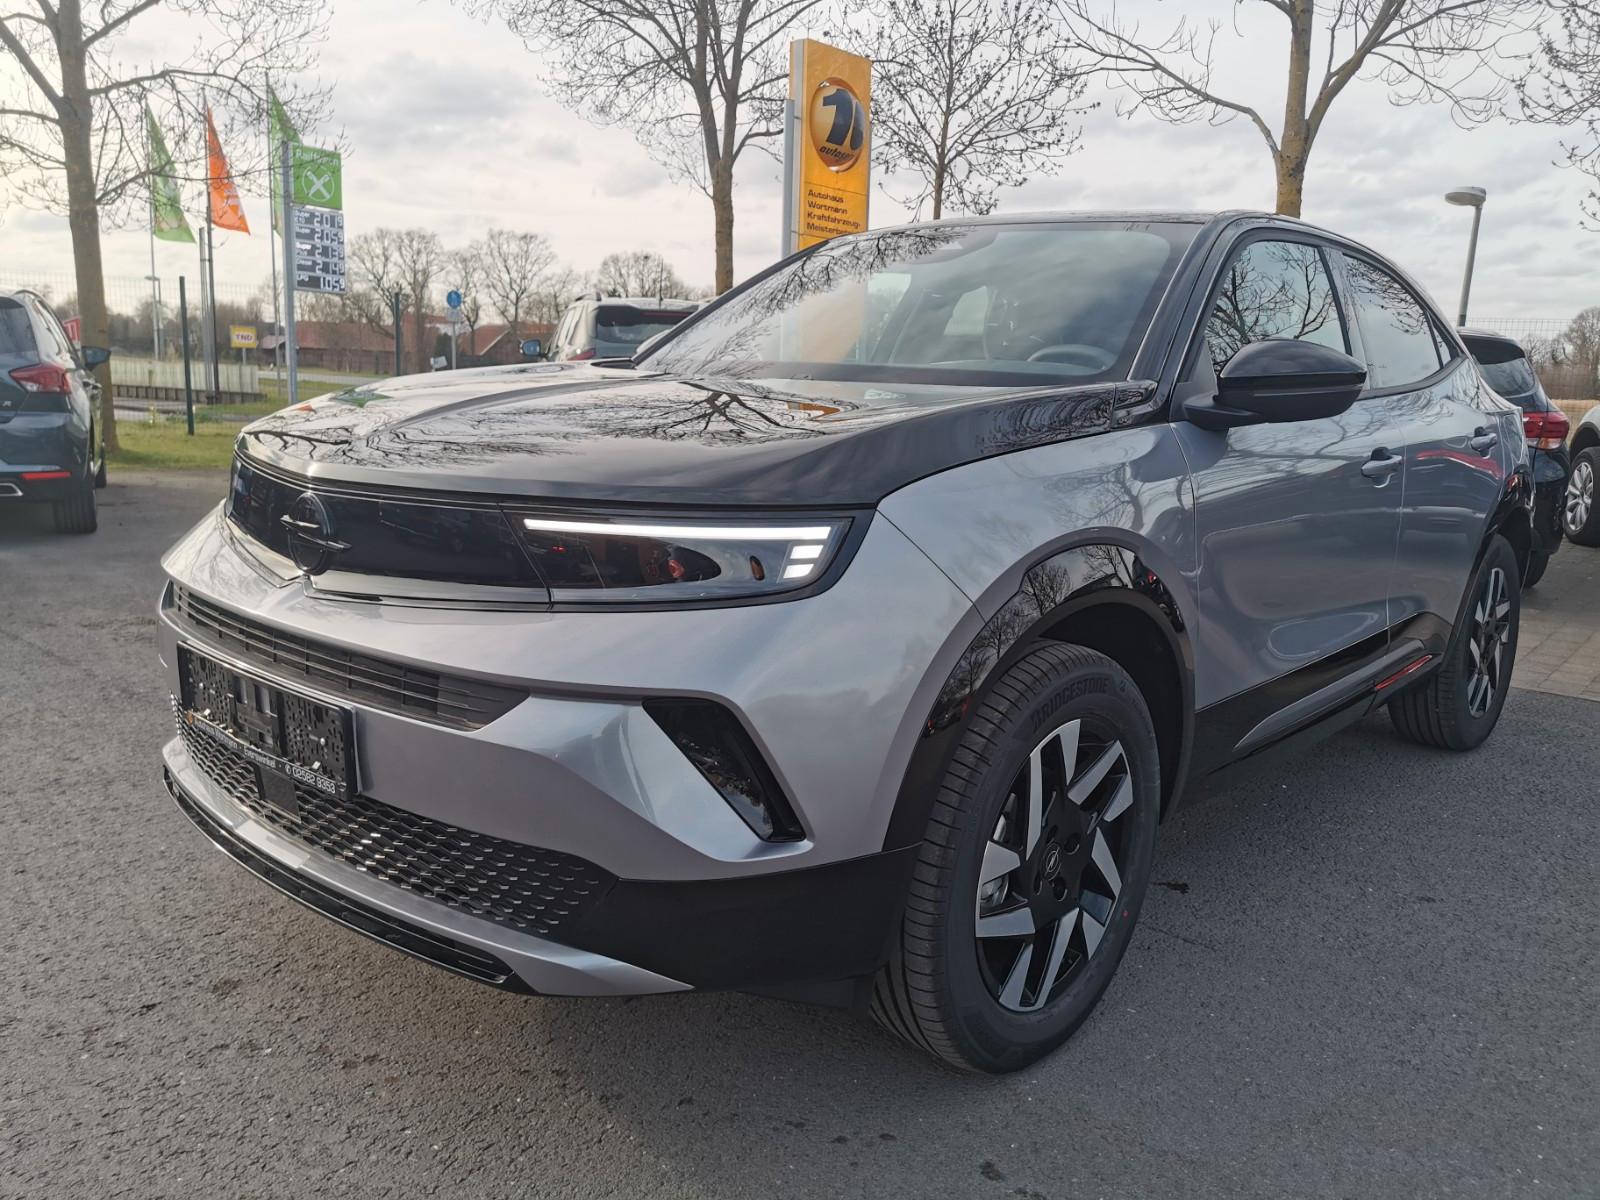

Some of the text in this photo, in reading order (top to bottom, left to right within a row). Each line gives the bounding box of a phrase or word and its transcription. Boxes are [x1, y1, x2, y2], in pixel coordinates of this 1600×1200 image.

[807, 189, 844, 203] Autohaus
[807, 200, 848, 215] Wortmann
[314, 228, 344, 246] 2059
[315, 260, 345, 277] 2149
[1028, 676, 1112, 735] BRIDGESTONE
[292, 765, 316, 786] 02582
